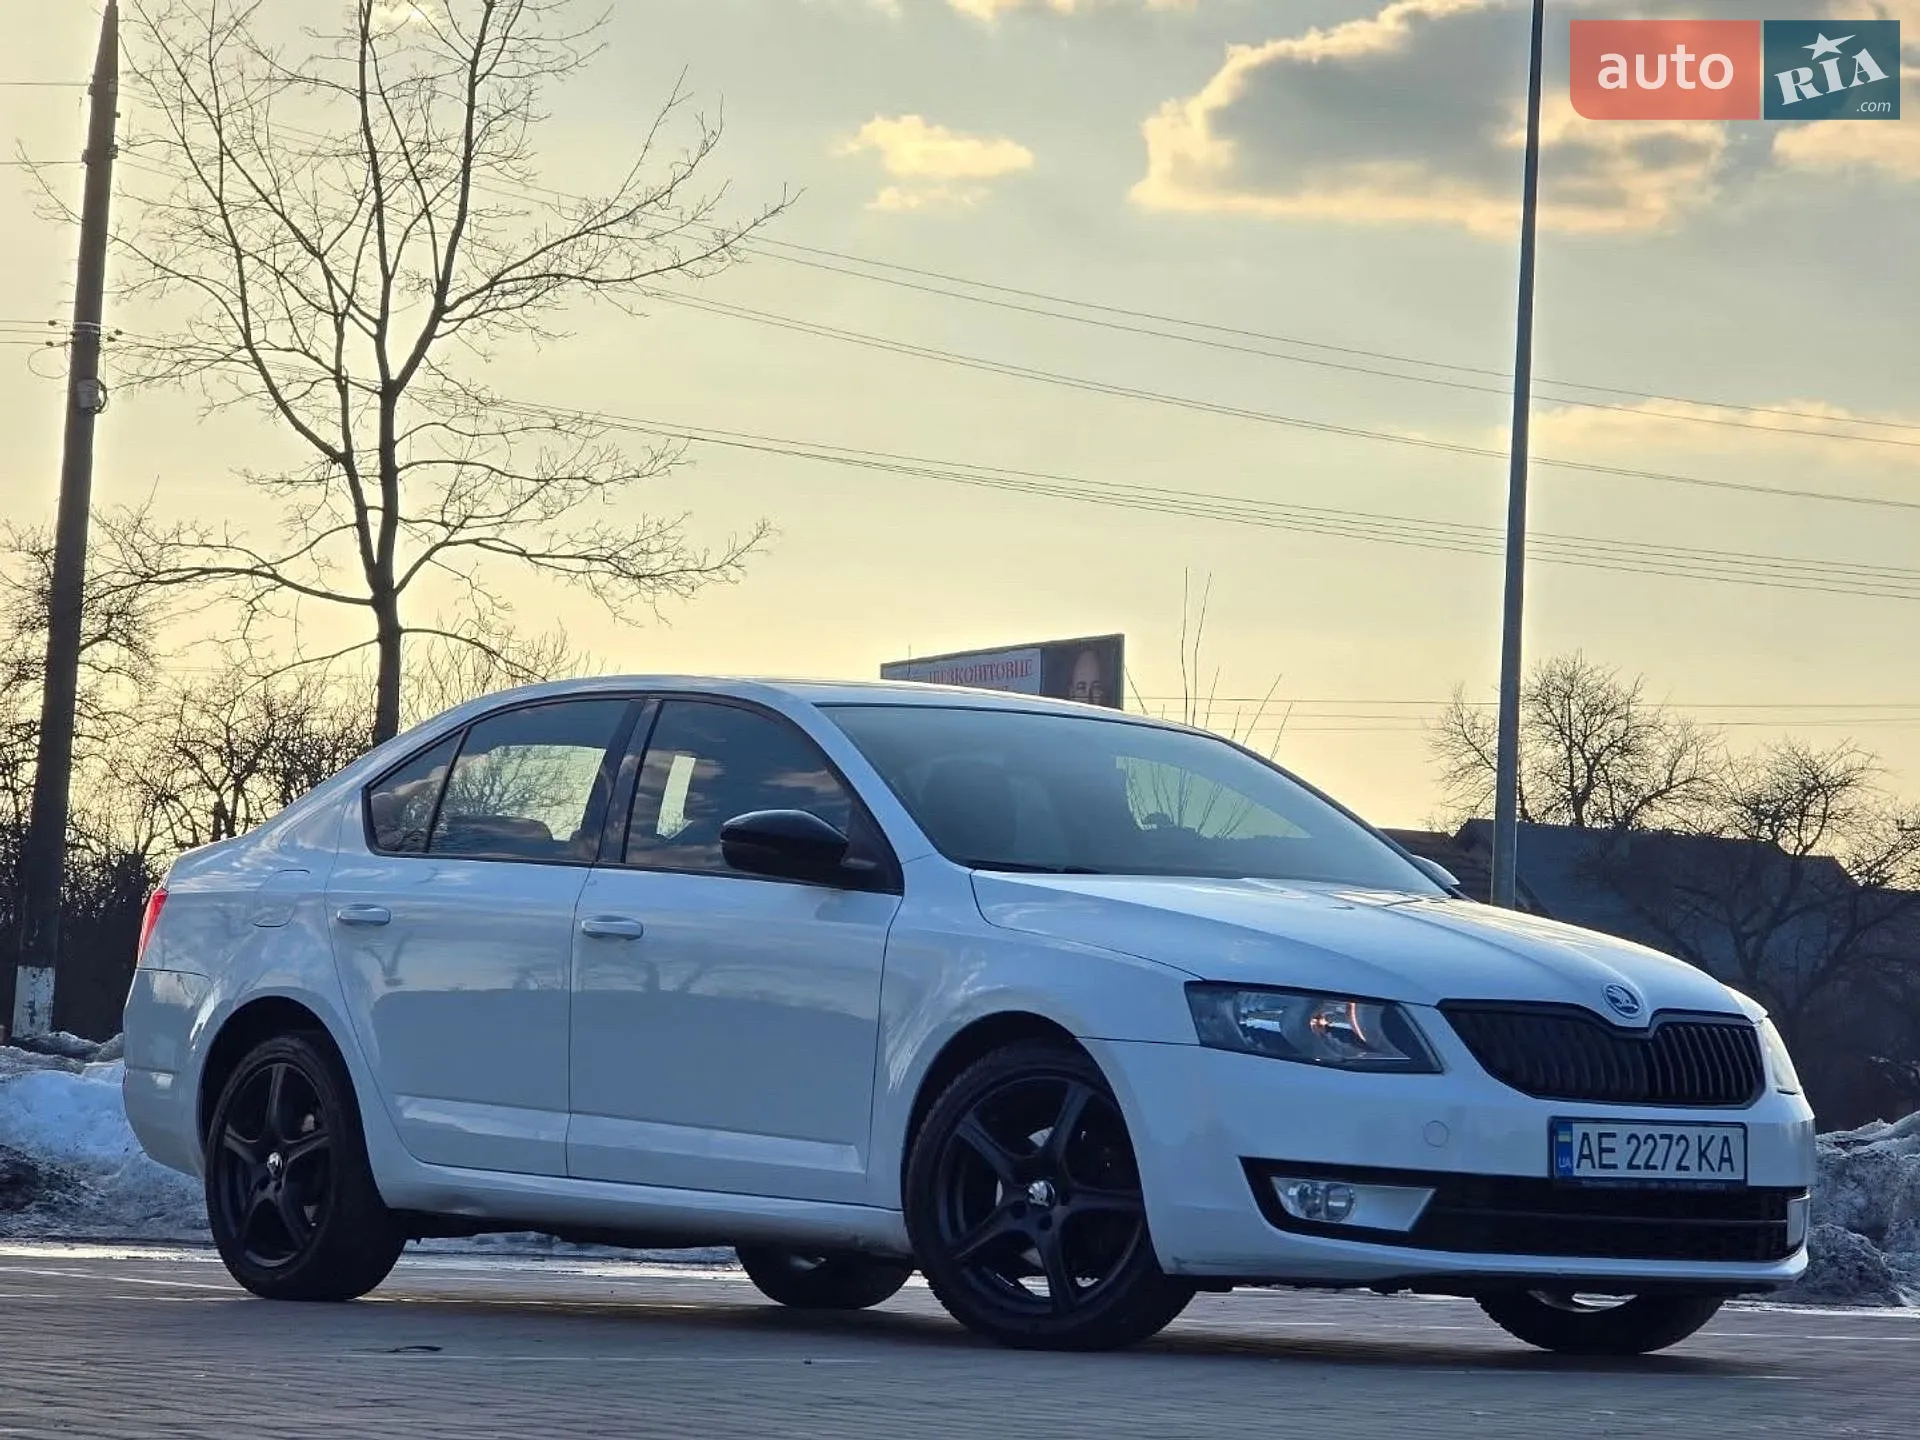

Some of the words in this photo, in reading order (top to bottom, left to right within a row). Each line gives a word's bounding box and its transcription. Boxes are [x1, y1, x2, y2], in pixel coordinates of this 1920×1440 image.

[1576, 1132, 1618, 1169] AE
[1626, 1133, 1690, 1172] 2272
[1697, 1135, 1735, 1172] KA
